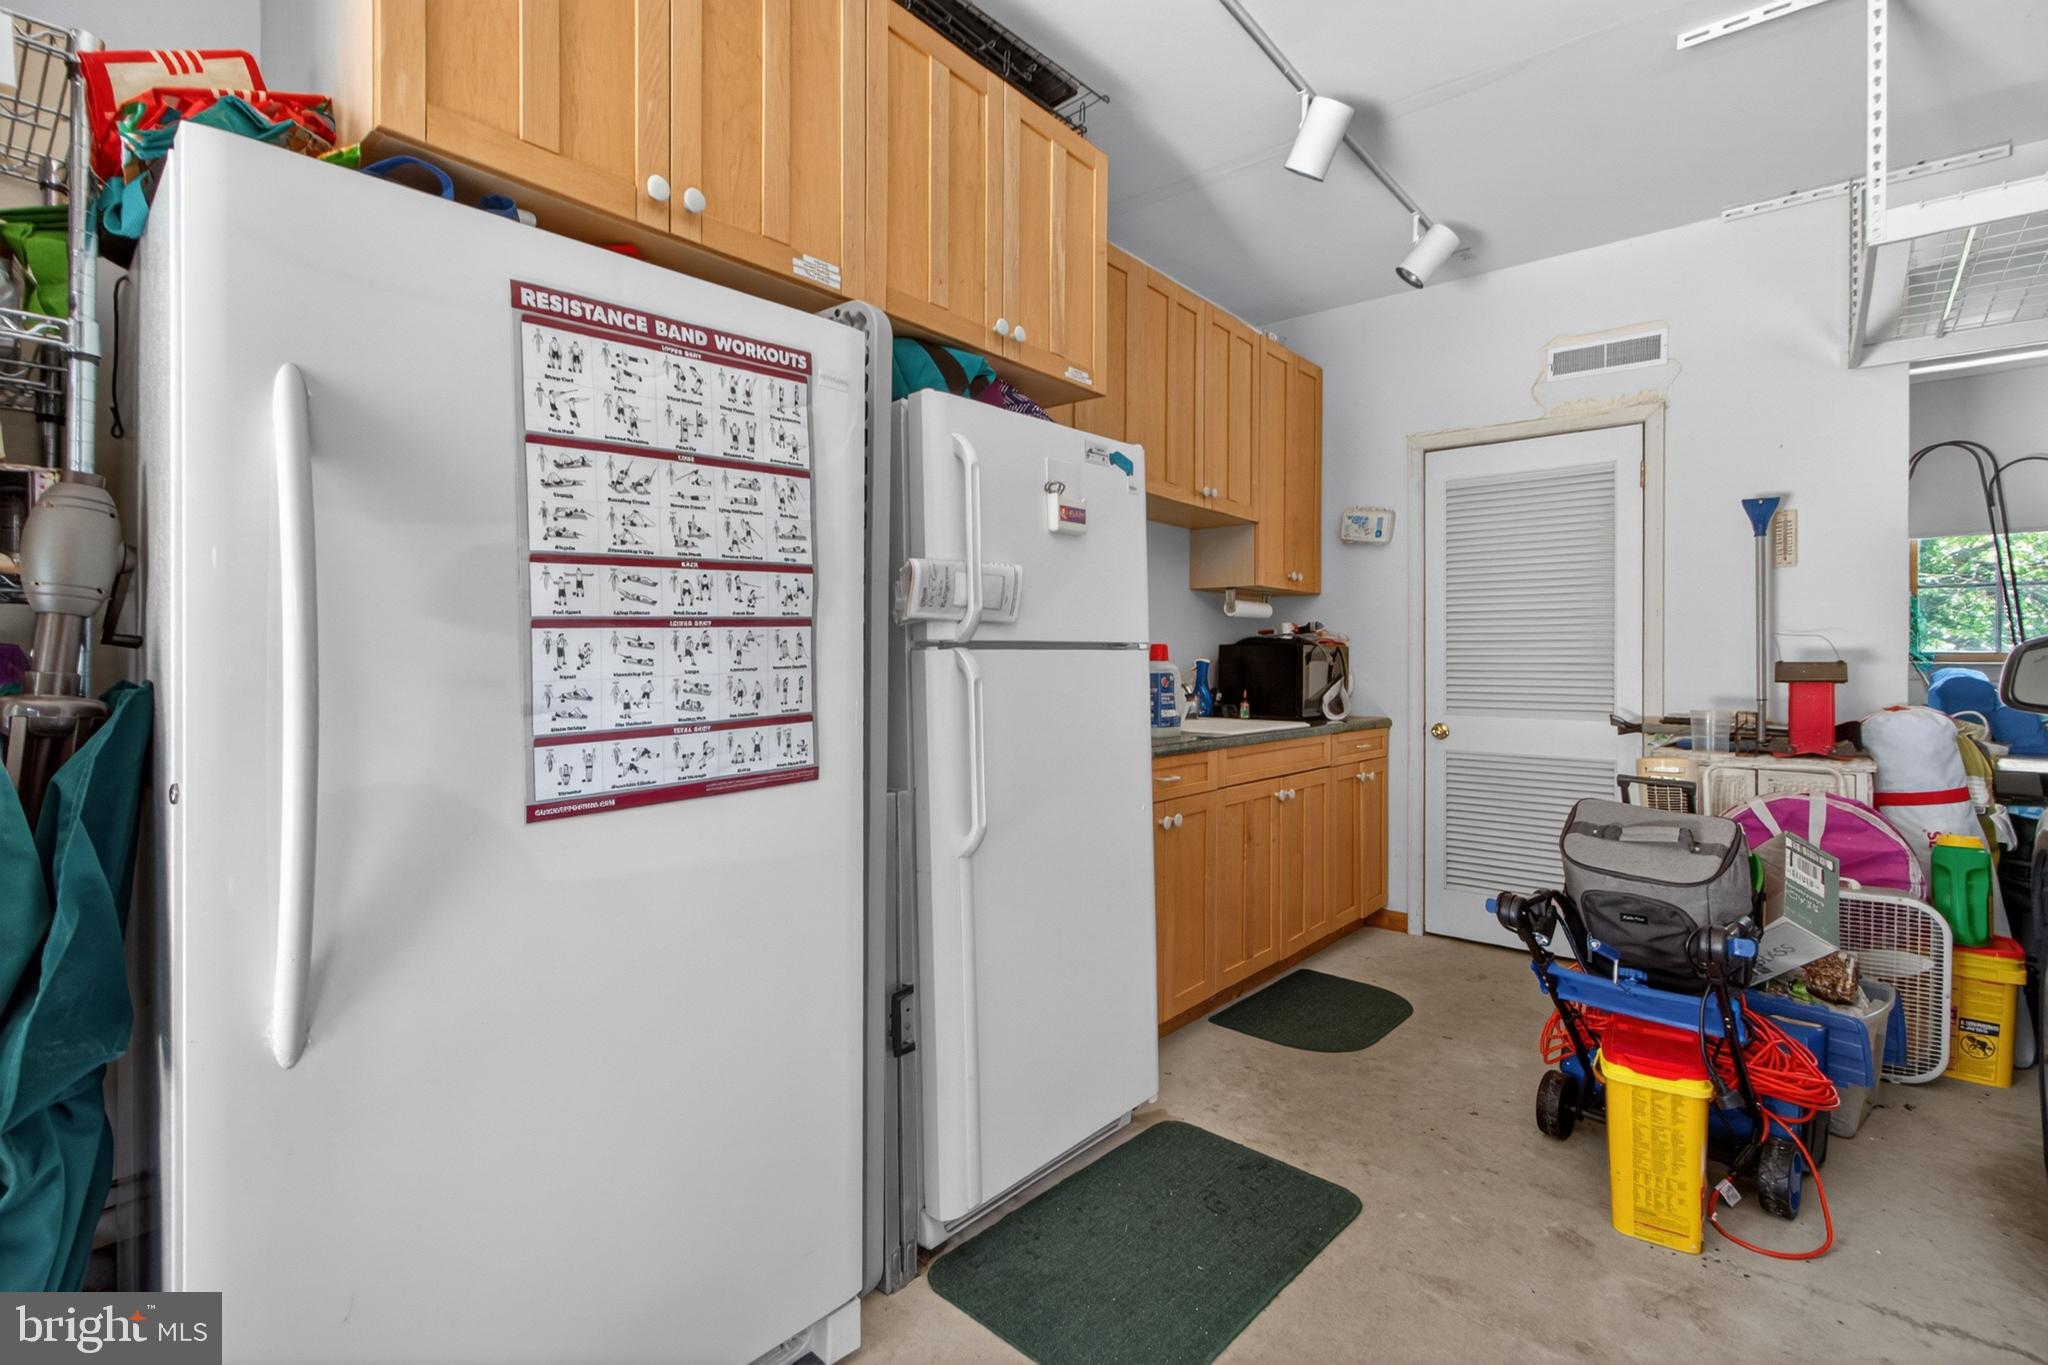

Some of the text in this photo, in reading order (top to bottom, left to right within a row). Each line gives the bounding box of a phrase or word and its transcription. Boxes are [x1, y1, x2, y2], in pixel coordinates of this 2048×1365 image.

[520, 286, 807, 370] RESISTANCE BAND WORKOUTS
